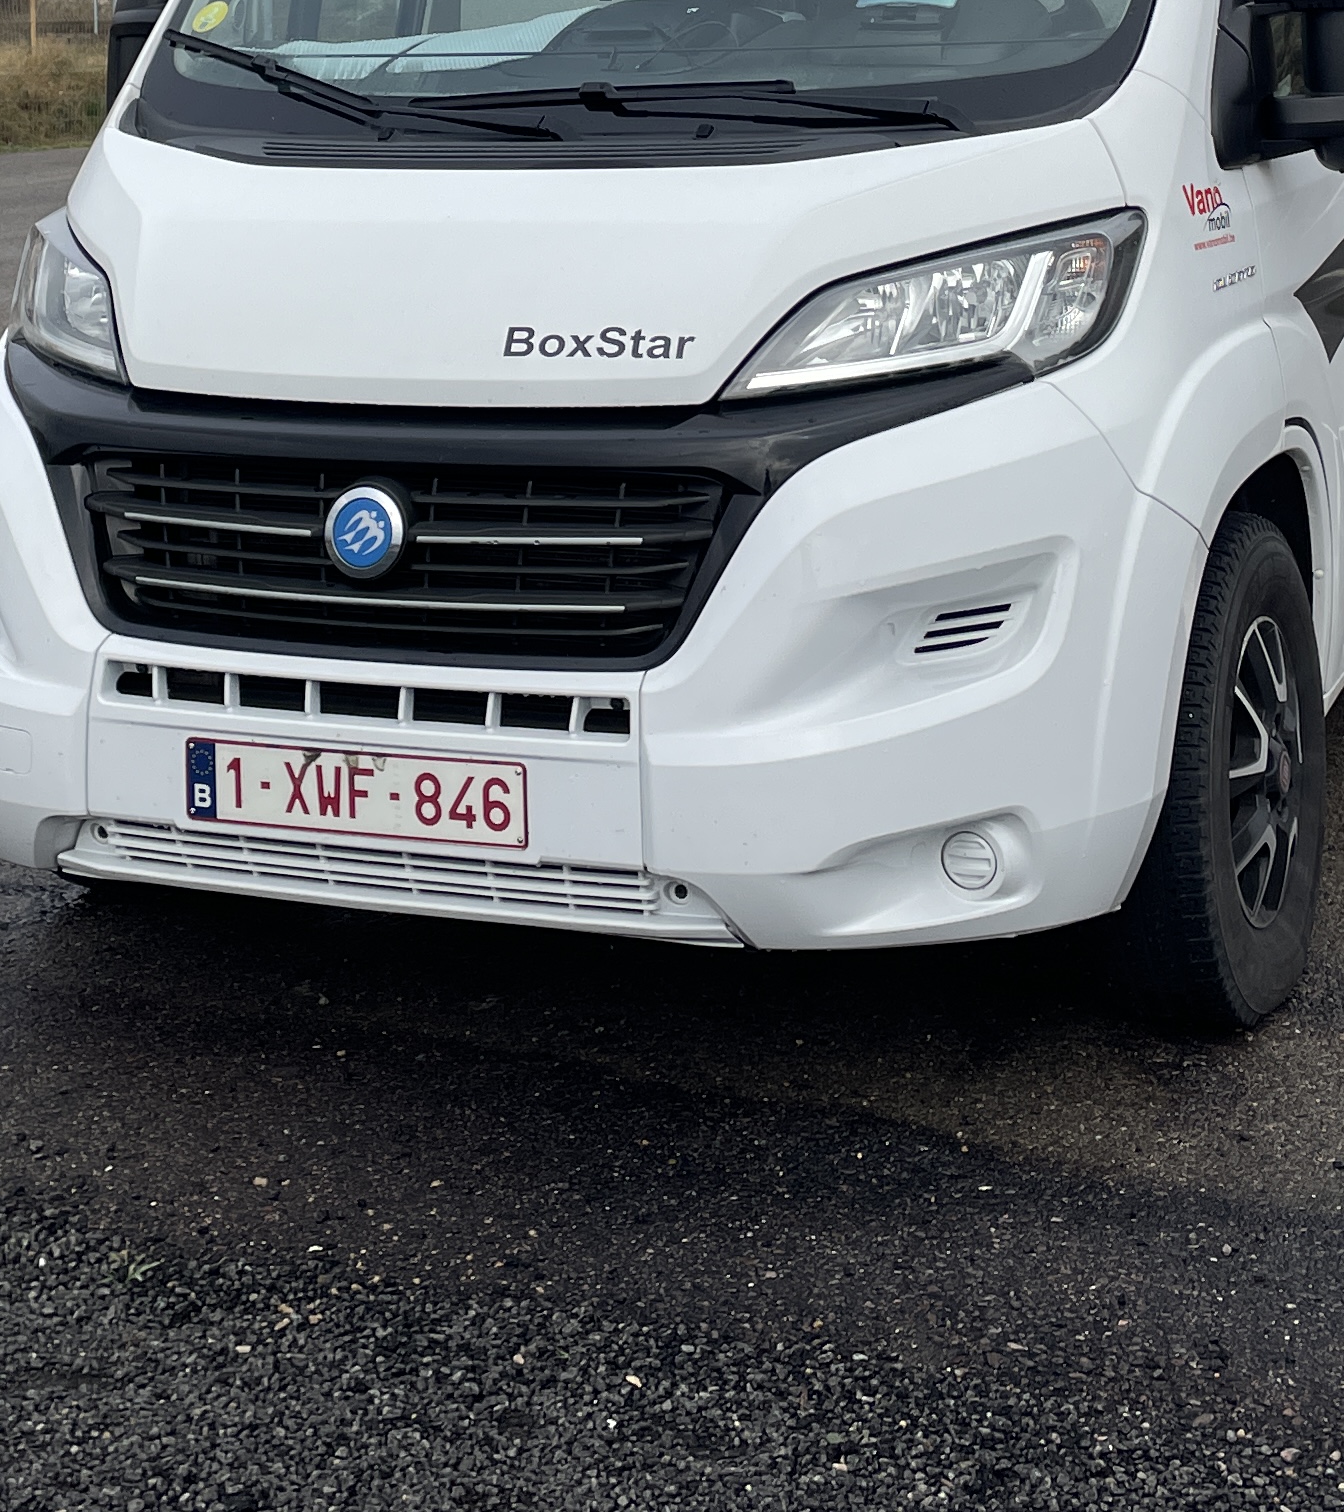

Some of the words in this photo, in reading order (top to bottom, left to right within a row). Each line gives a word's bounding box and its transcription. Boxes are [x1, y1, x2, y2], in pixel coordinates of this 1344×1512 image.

[1208, 211, 1230, 231] mobil
[503, 326, 696, 359] BoxStar
[193, 783, 212, 808] B
[226, 757, 511, 832] 1-XWF-846
